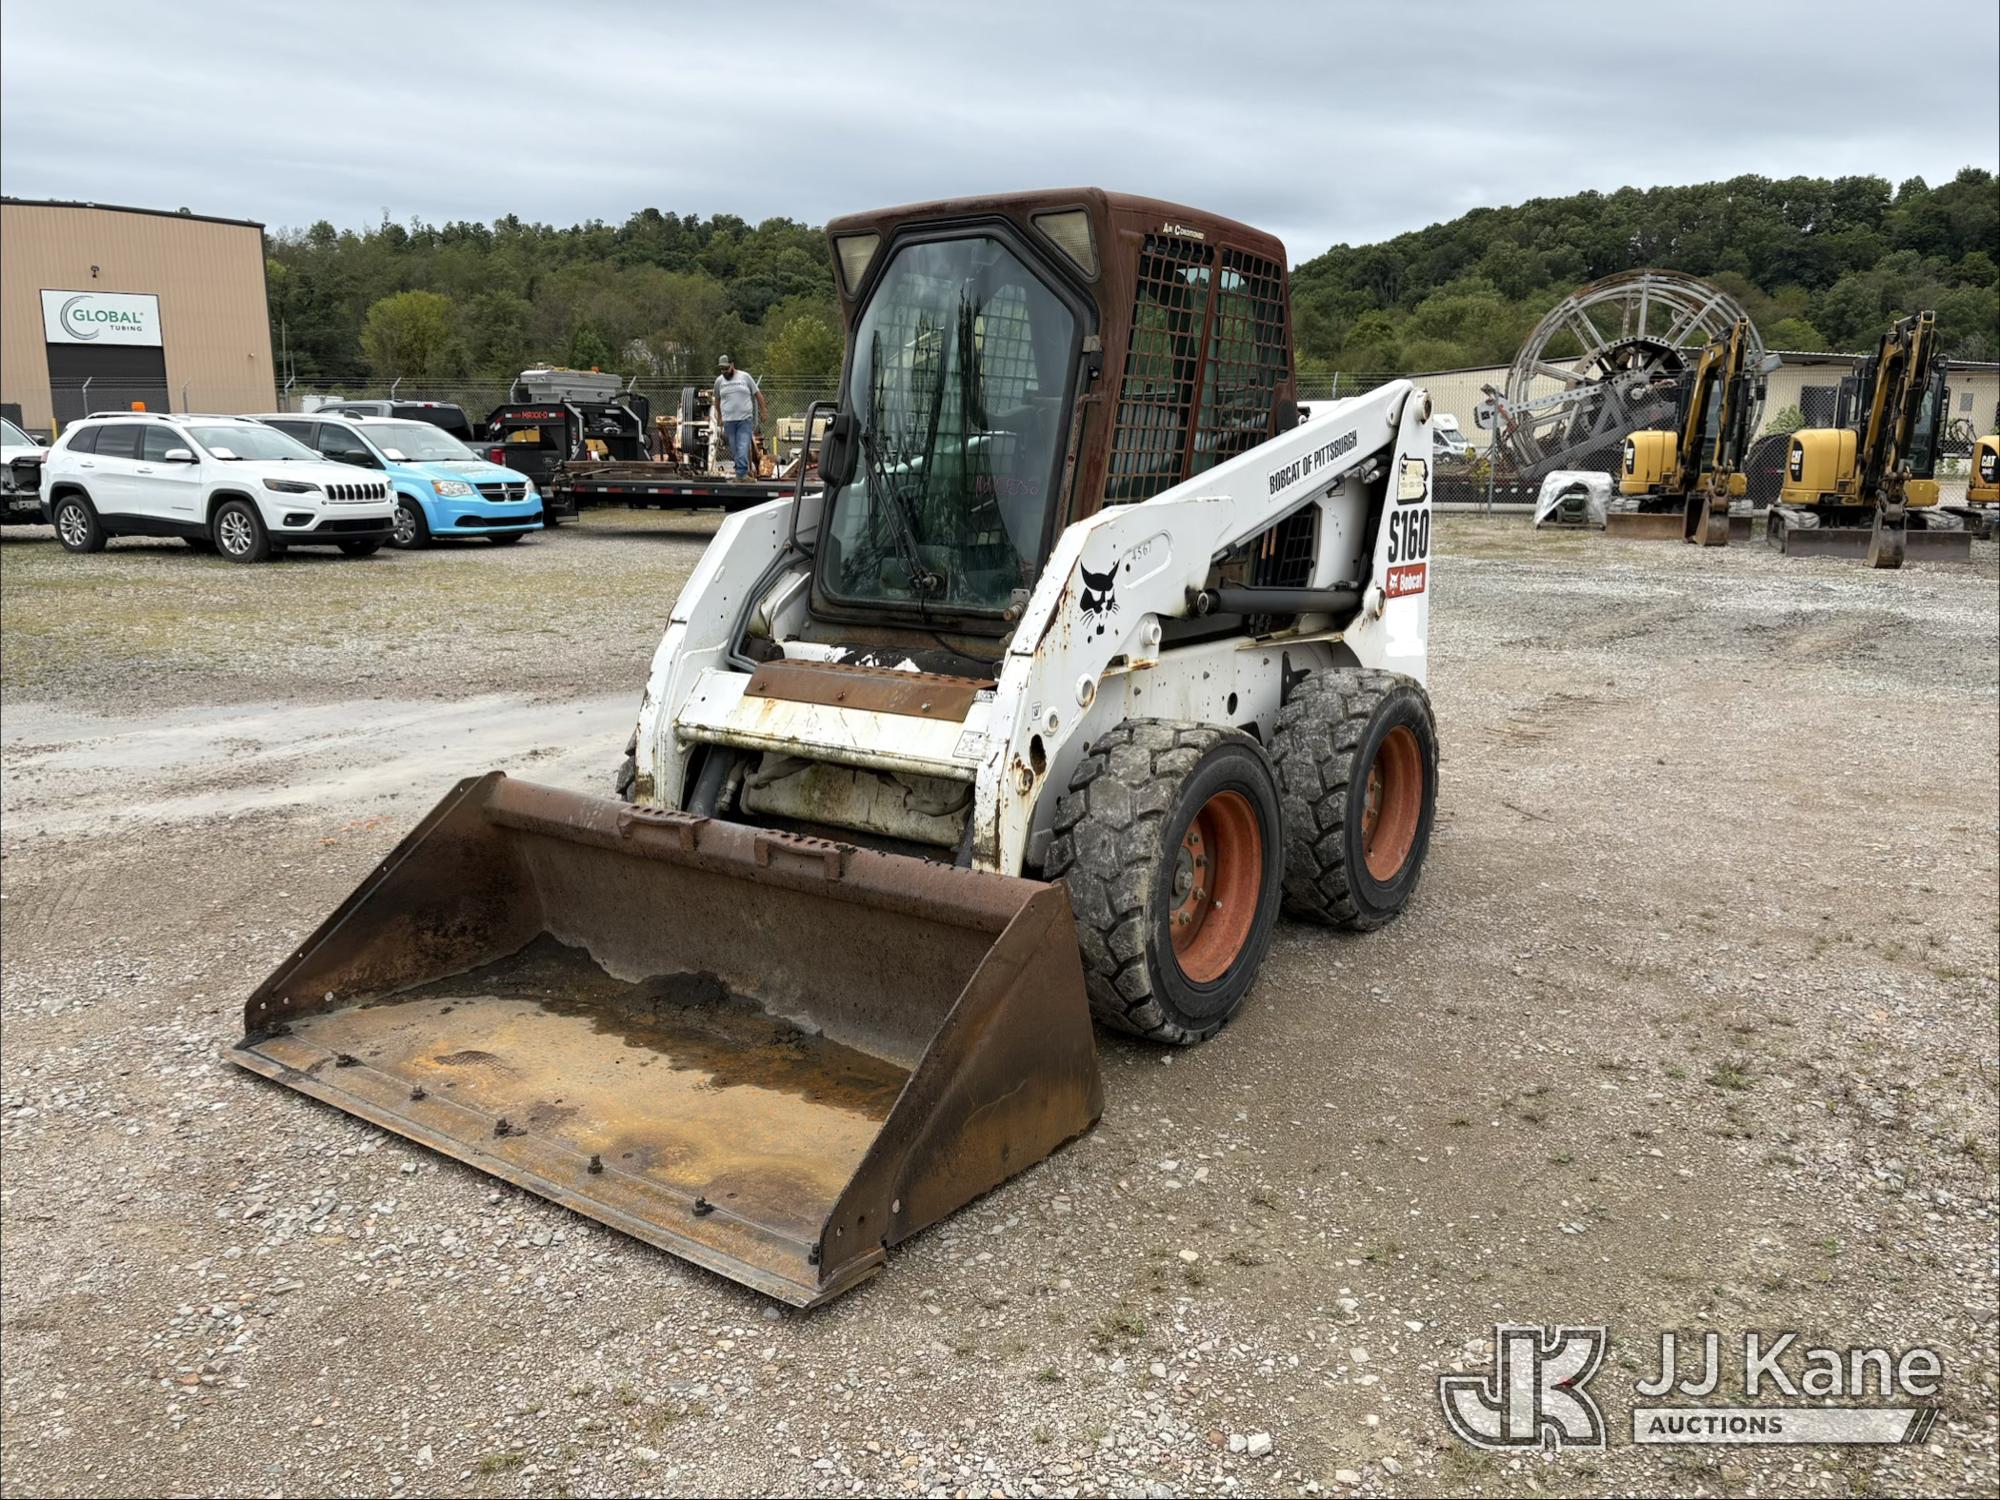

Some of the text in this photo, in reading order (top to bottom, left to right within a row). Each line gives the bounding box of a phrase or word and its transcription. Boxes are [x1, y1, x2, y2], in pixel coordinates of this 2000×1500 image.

[72, 309, 142, 324] GLOBAL
[110, 324, 143, 332] TUBING
[1269, 429, 1358, 495] BOBCAT OF PITTSBURGH
[1981, 455, 1997, 467] CAT
[1387, 508, 1430, 563] S160
[1399, 570, 1424, 592] Bobcat
